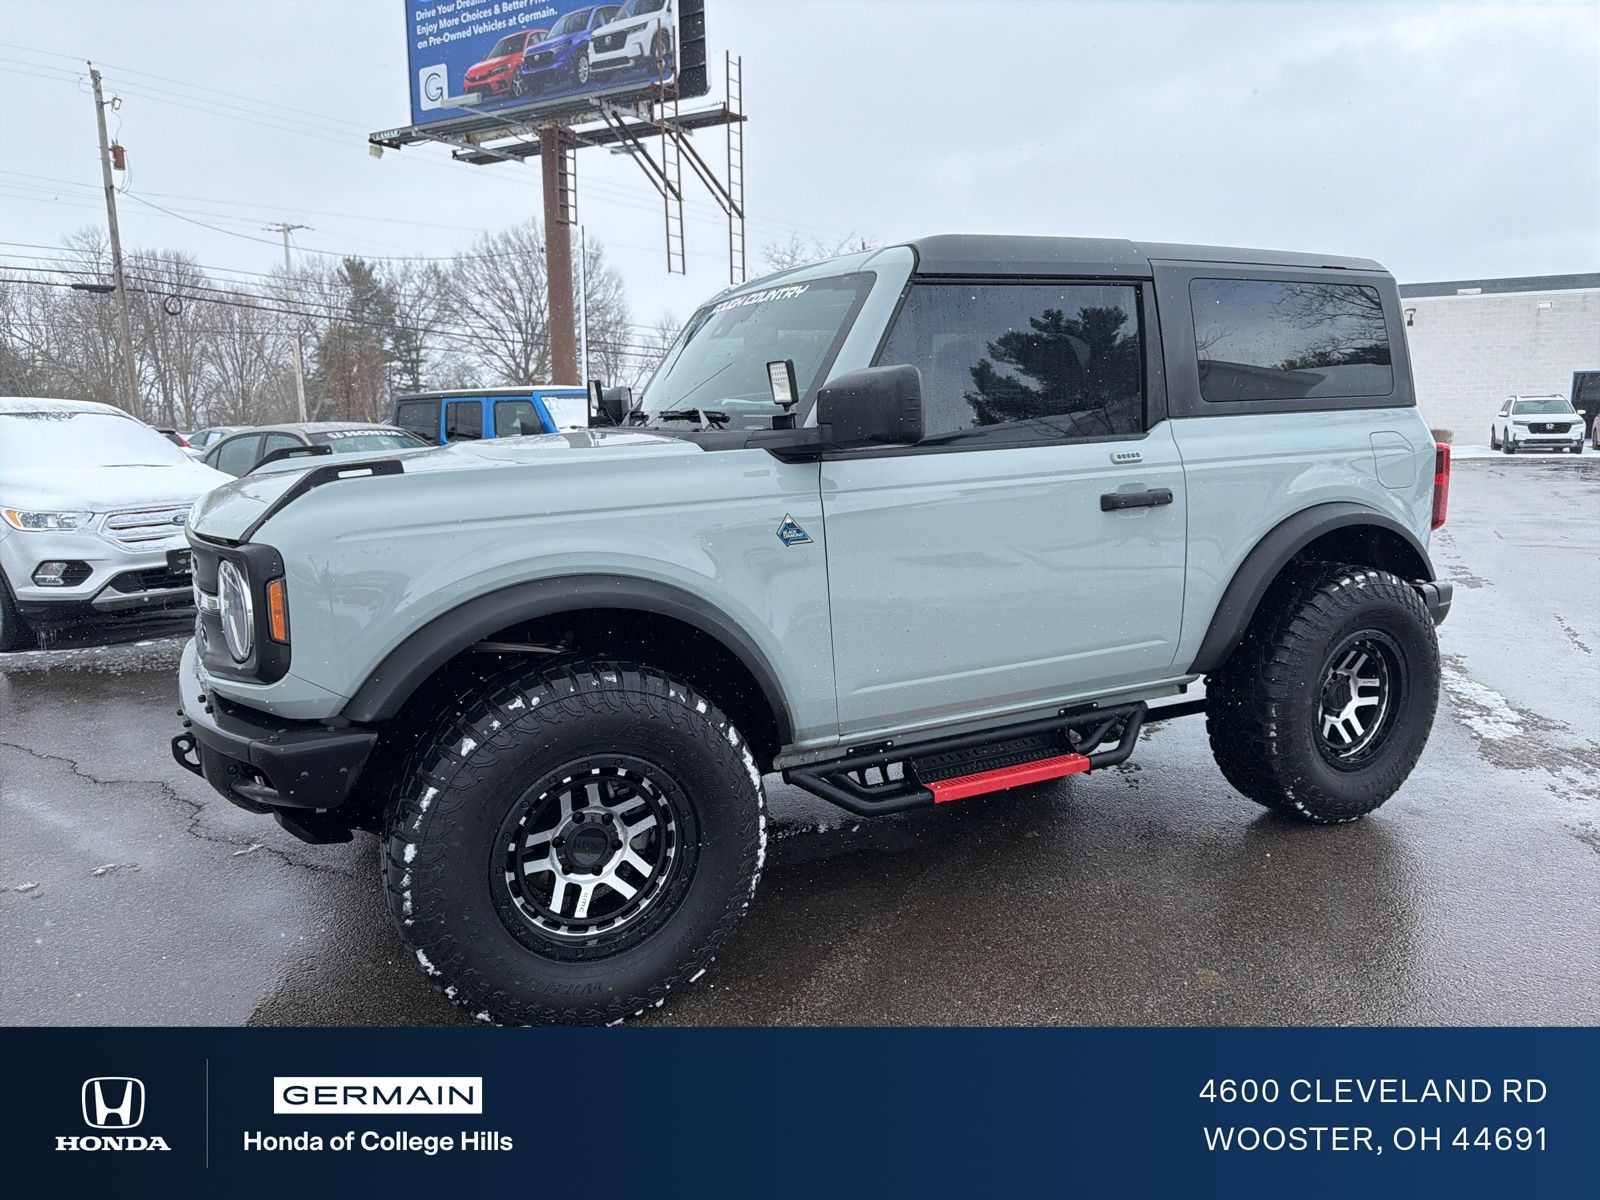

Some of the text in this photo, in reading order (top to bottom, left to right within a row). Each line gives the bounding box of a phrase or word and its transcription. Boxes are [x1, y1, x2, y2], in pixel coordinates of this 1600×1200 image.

[415, 8, 437, 21] Drive
[436, 4, 456, 15] Your
[416, 22, 438, 36] Enjoy
[439, 18, 460, 30] More
[460, 8, 493, 24] Choices
[493, 4, 501, 14] &
[501, 0, 528, 13] Better
[417, 6, 558, 49] on Pre-Owned Vehicles at Germain.
[742, 285, 809, 305] COUNTRY
